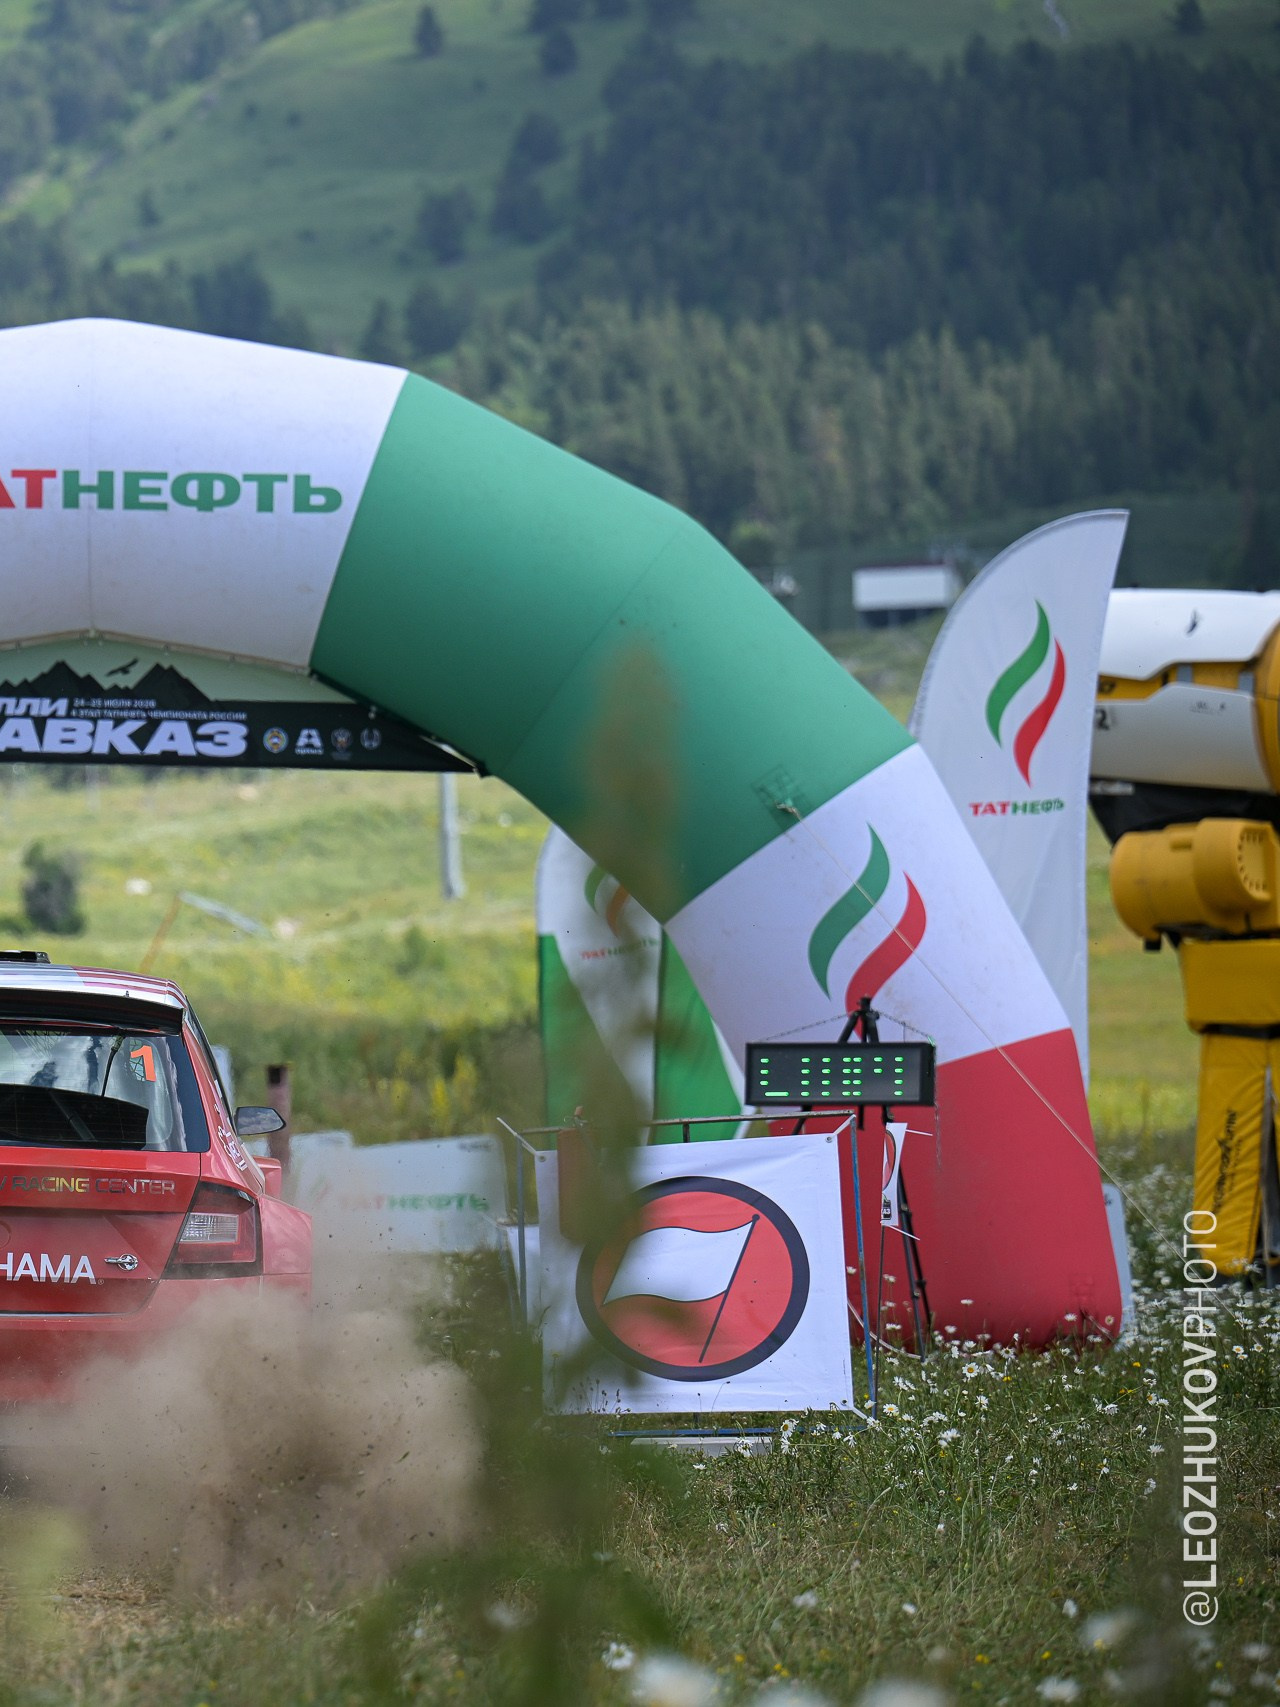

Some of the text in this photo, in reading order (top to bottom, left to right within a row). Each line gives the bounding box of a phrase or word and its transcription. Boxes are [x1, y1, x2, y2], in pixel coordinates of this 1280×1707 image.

[130, 1045, 157, 1082] 1
[11, 1176, 90, 1193] RACING
[95, 1178, 176, 1195] CENTER
